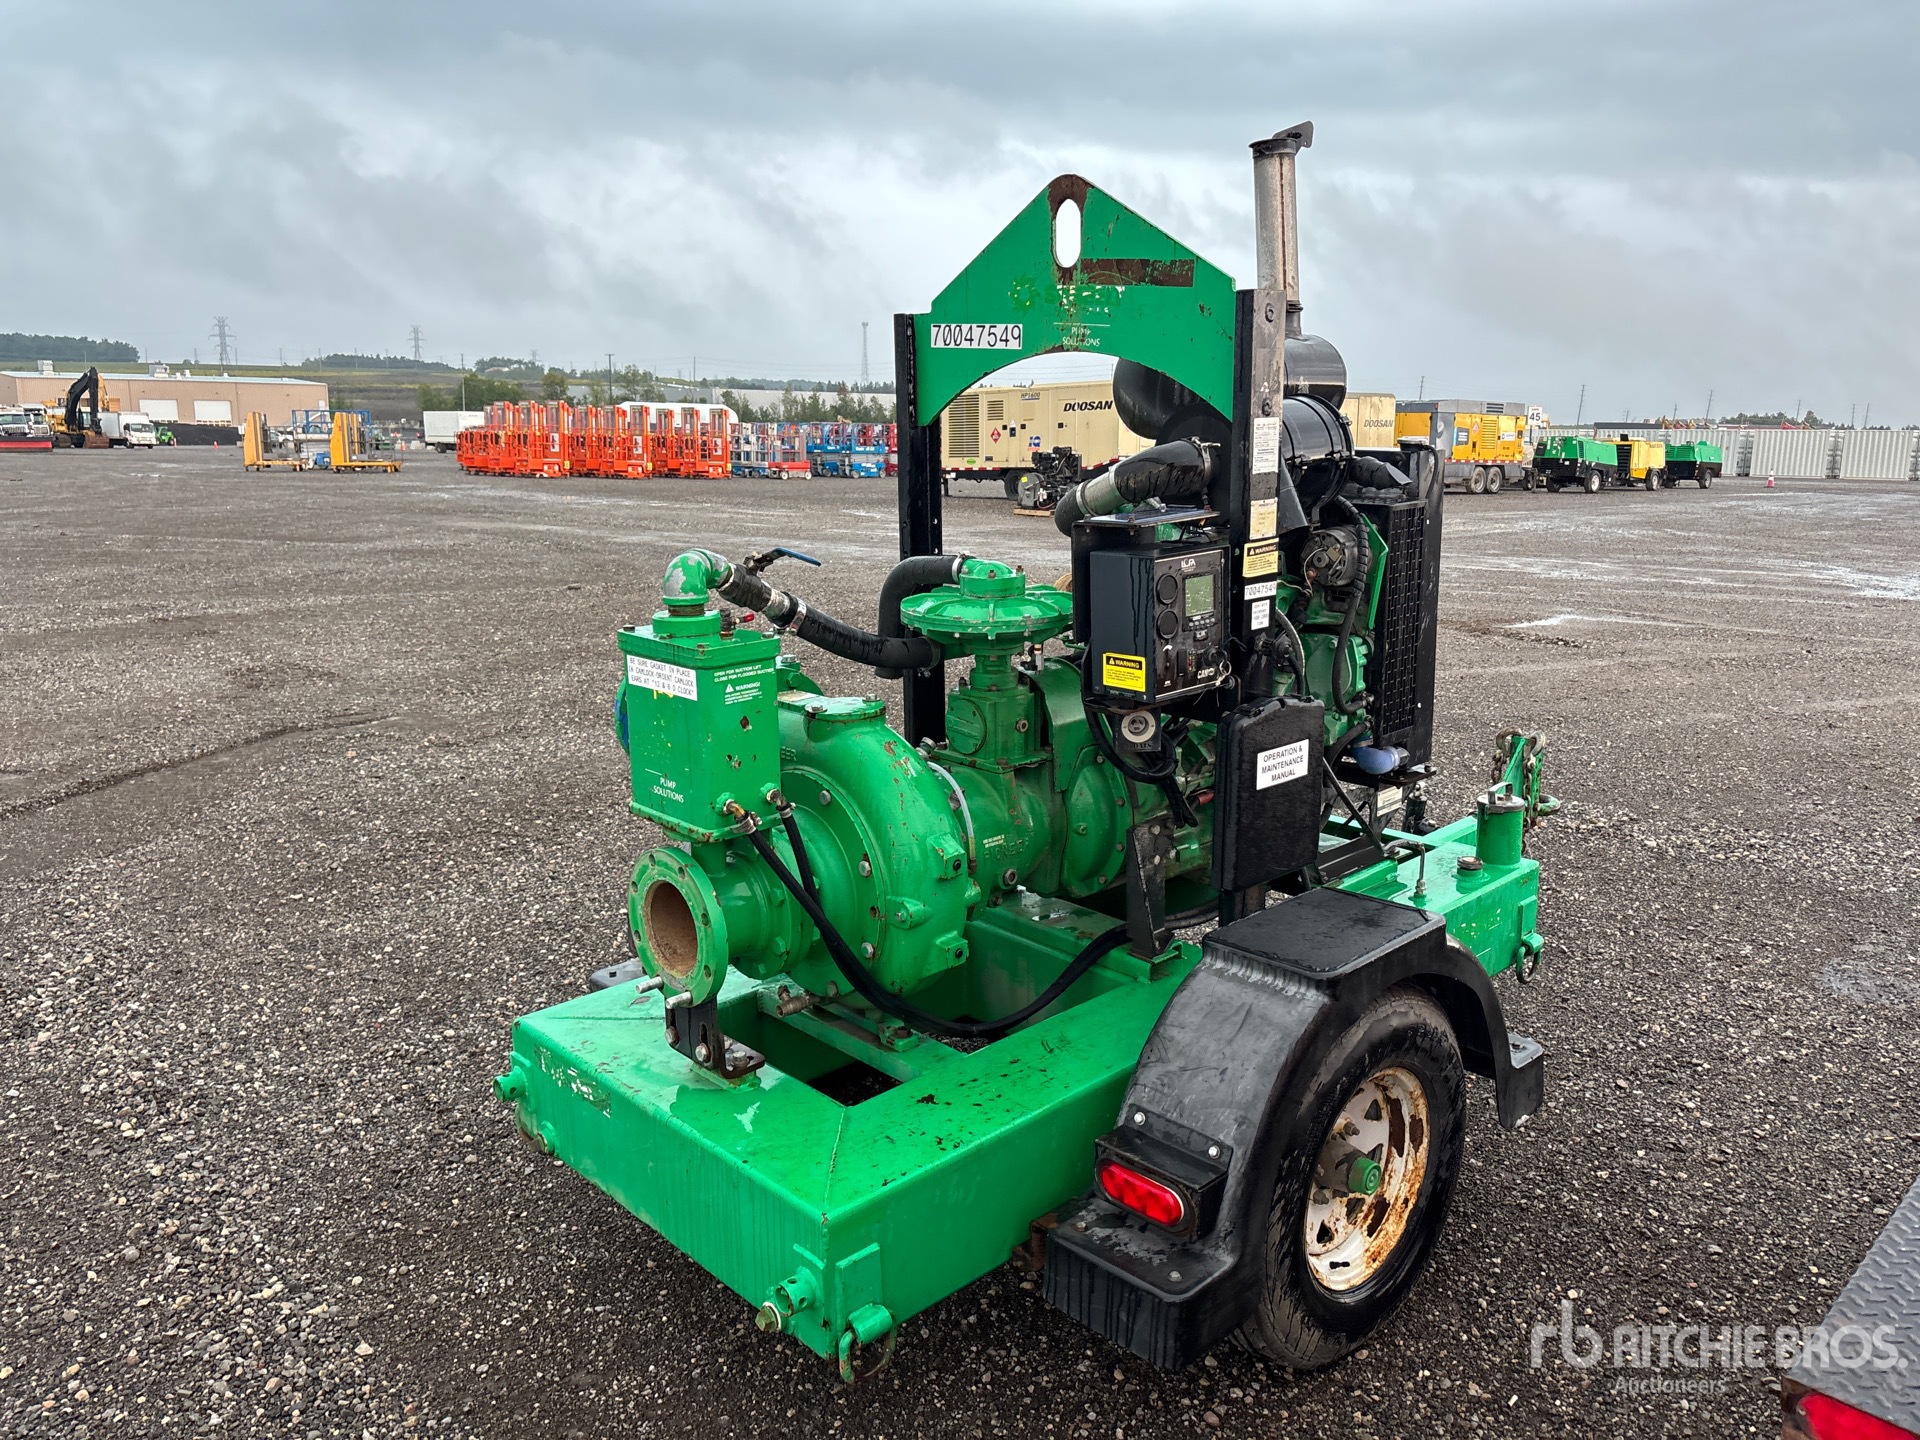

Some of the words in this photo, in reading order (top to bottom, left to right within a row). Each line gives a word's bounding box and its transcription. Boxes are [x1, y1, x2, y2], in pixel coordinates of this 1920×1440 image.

[932, 324, 1021, 348] 70047549
[1021, 391, 1041, 399] HP1600
[1063, 400, 1113, 412] DOOSAN
[1364, 419, 1394, 428] DOOSAN
[1529, 412, 1541, 421] 45
[1254, 544, 1277, 554] WARNING
[629, 657, 636, 665] BE
[637, 659, 648, 668] SURE
[650, 662, 667, 672] GASKET
[669, 665, 675, 674] IN
[677, 668, 691, 678] PLACE
[1114, 659, 1140, 669] WARNING
[628, 665, 635, 673] IN
[675, 676, 694, 687] CAMLOCK
[631, 674, 642, 684] EARS
[1263, 746, 1298, 763] OPERATION
[1298, 744, 1303, 753] &
[1261, 754, 1304, 774] MAINTENANCE
[1271, 768, 1296, 782] MANUAL
[660, 776, 677, 790] PUMP
[653, 785, 684, 803] SOLUTIONS
